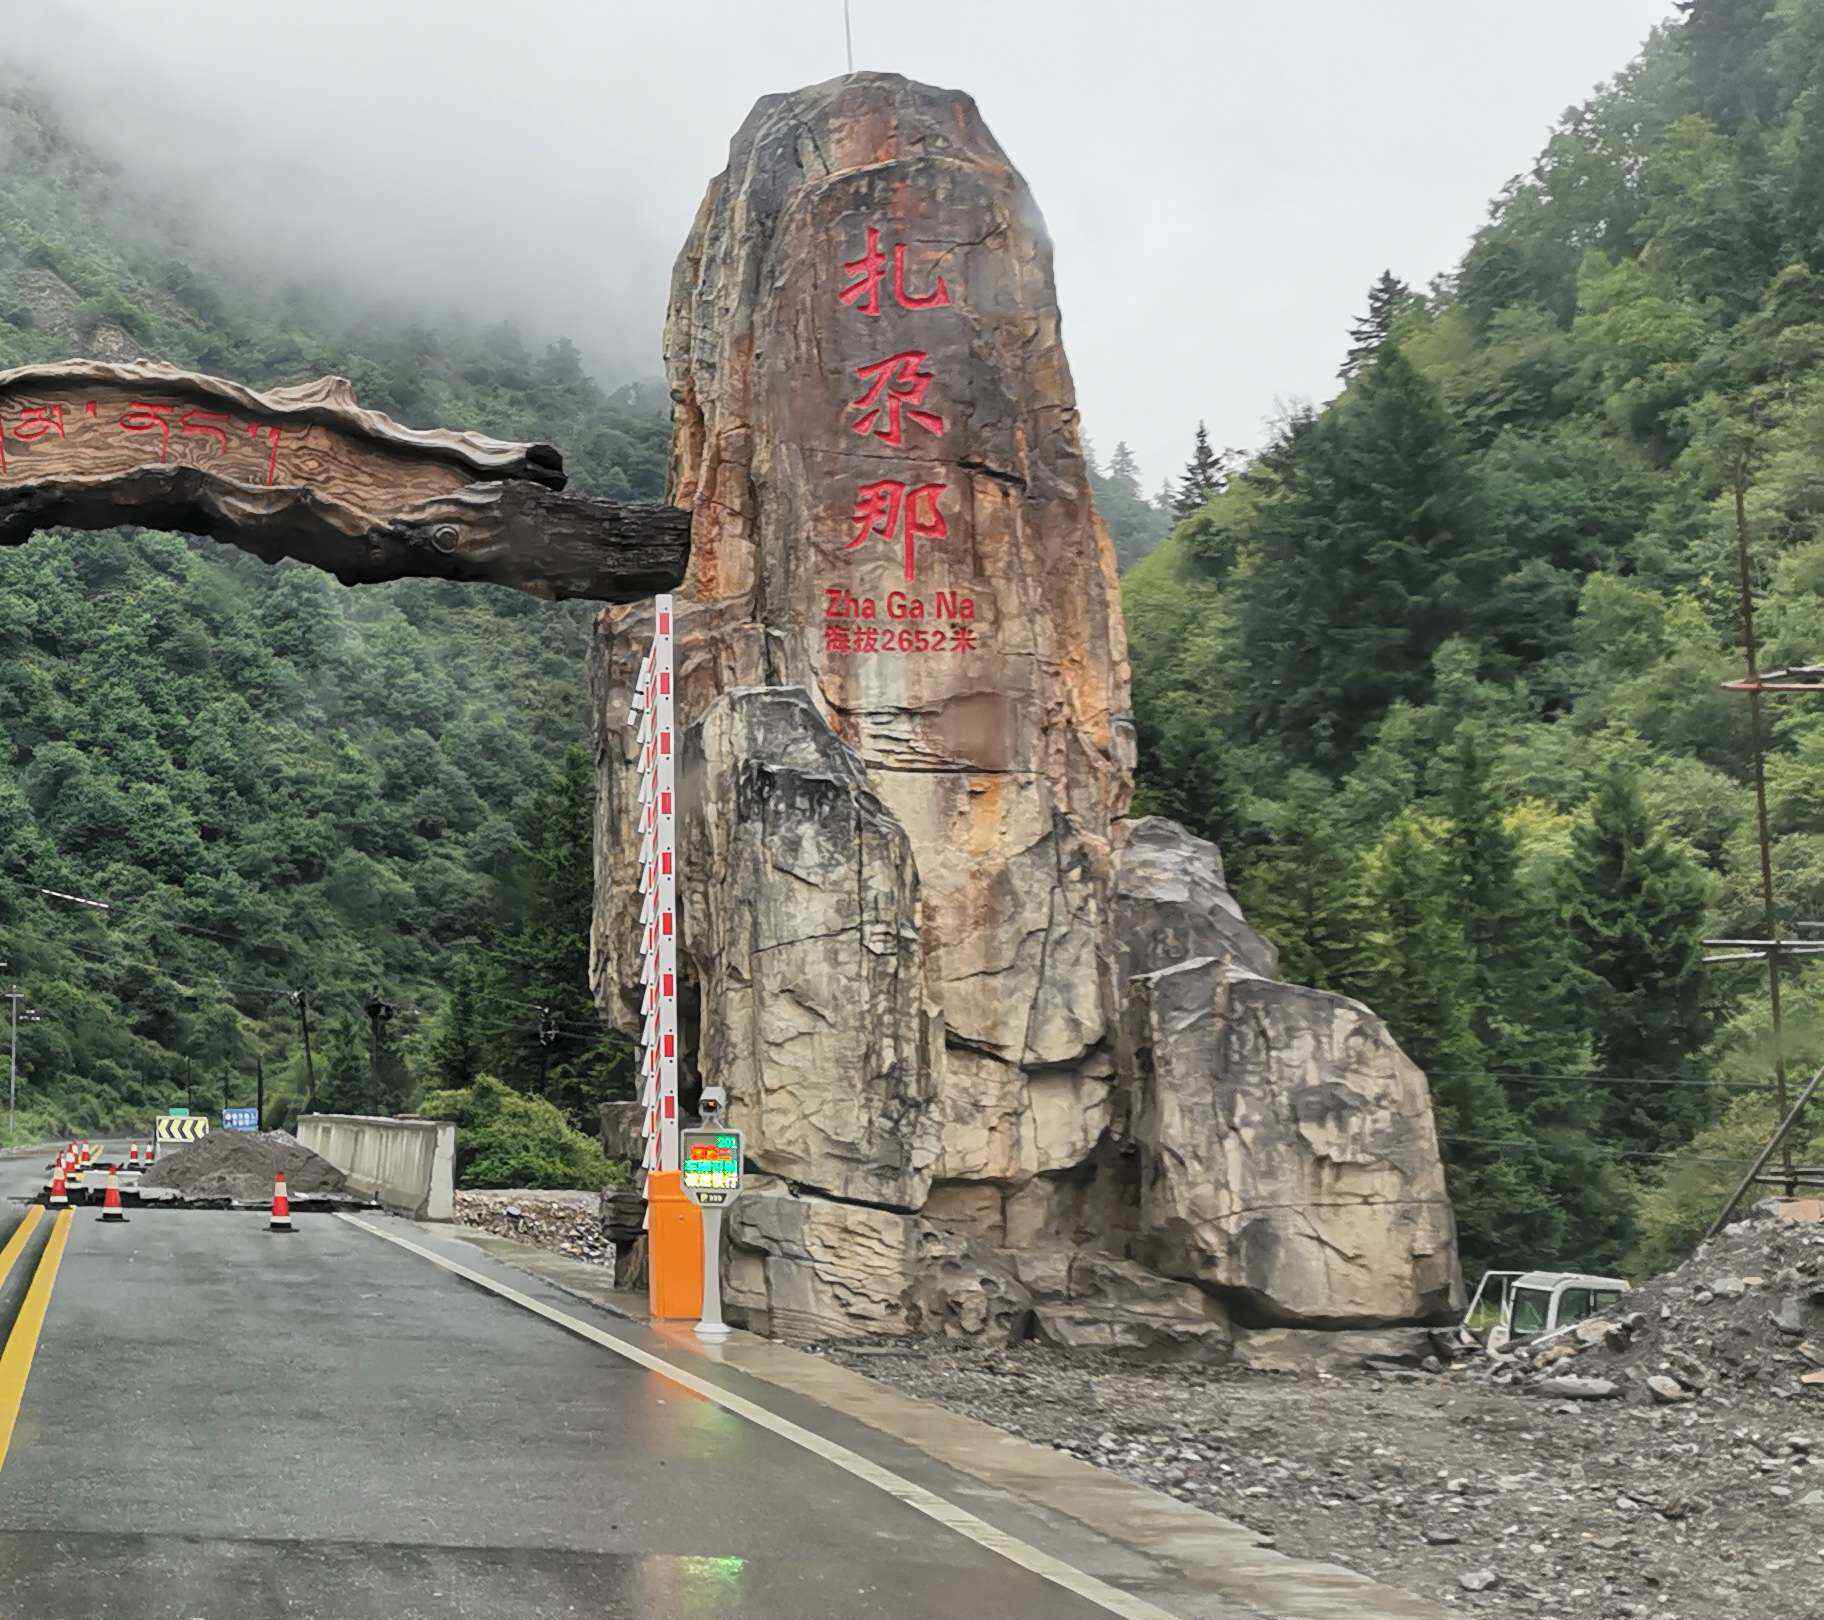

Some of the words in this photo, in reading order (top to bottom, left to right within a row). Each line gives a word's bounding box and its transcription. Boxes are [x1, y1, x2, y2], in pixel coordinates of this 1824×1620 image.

[838, 228, 950, 582] 扎尕那
[826, 589, 876, 619] Zha
[887, 591, 925, 620] Ga
[936, 591, 975, 619] Na
[825, 626, 977, 654] 海拔2652米
